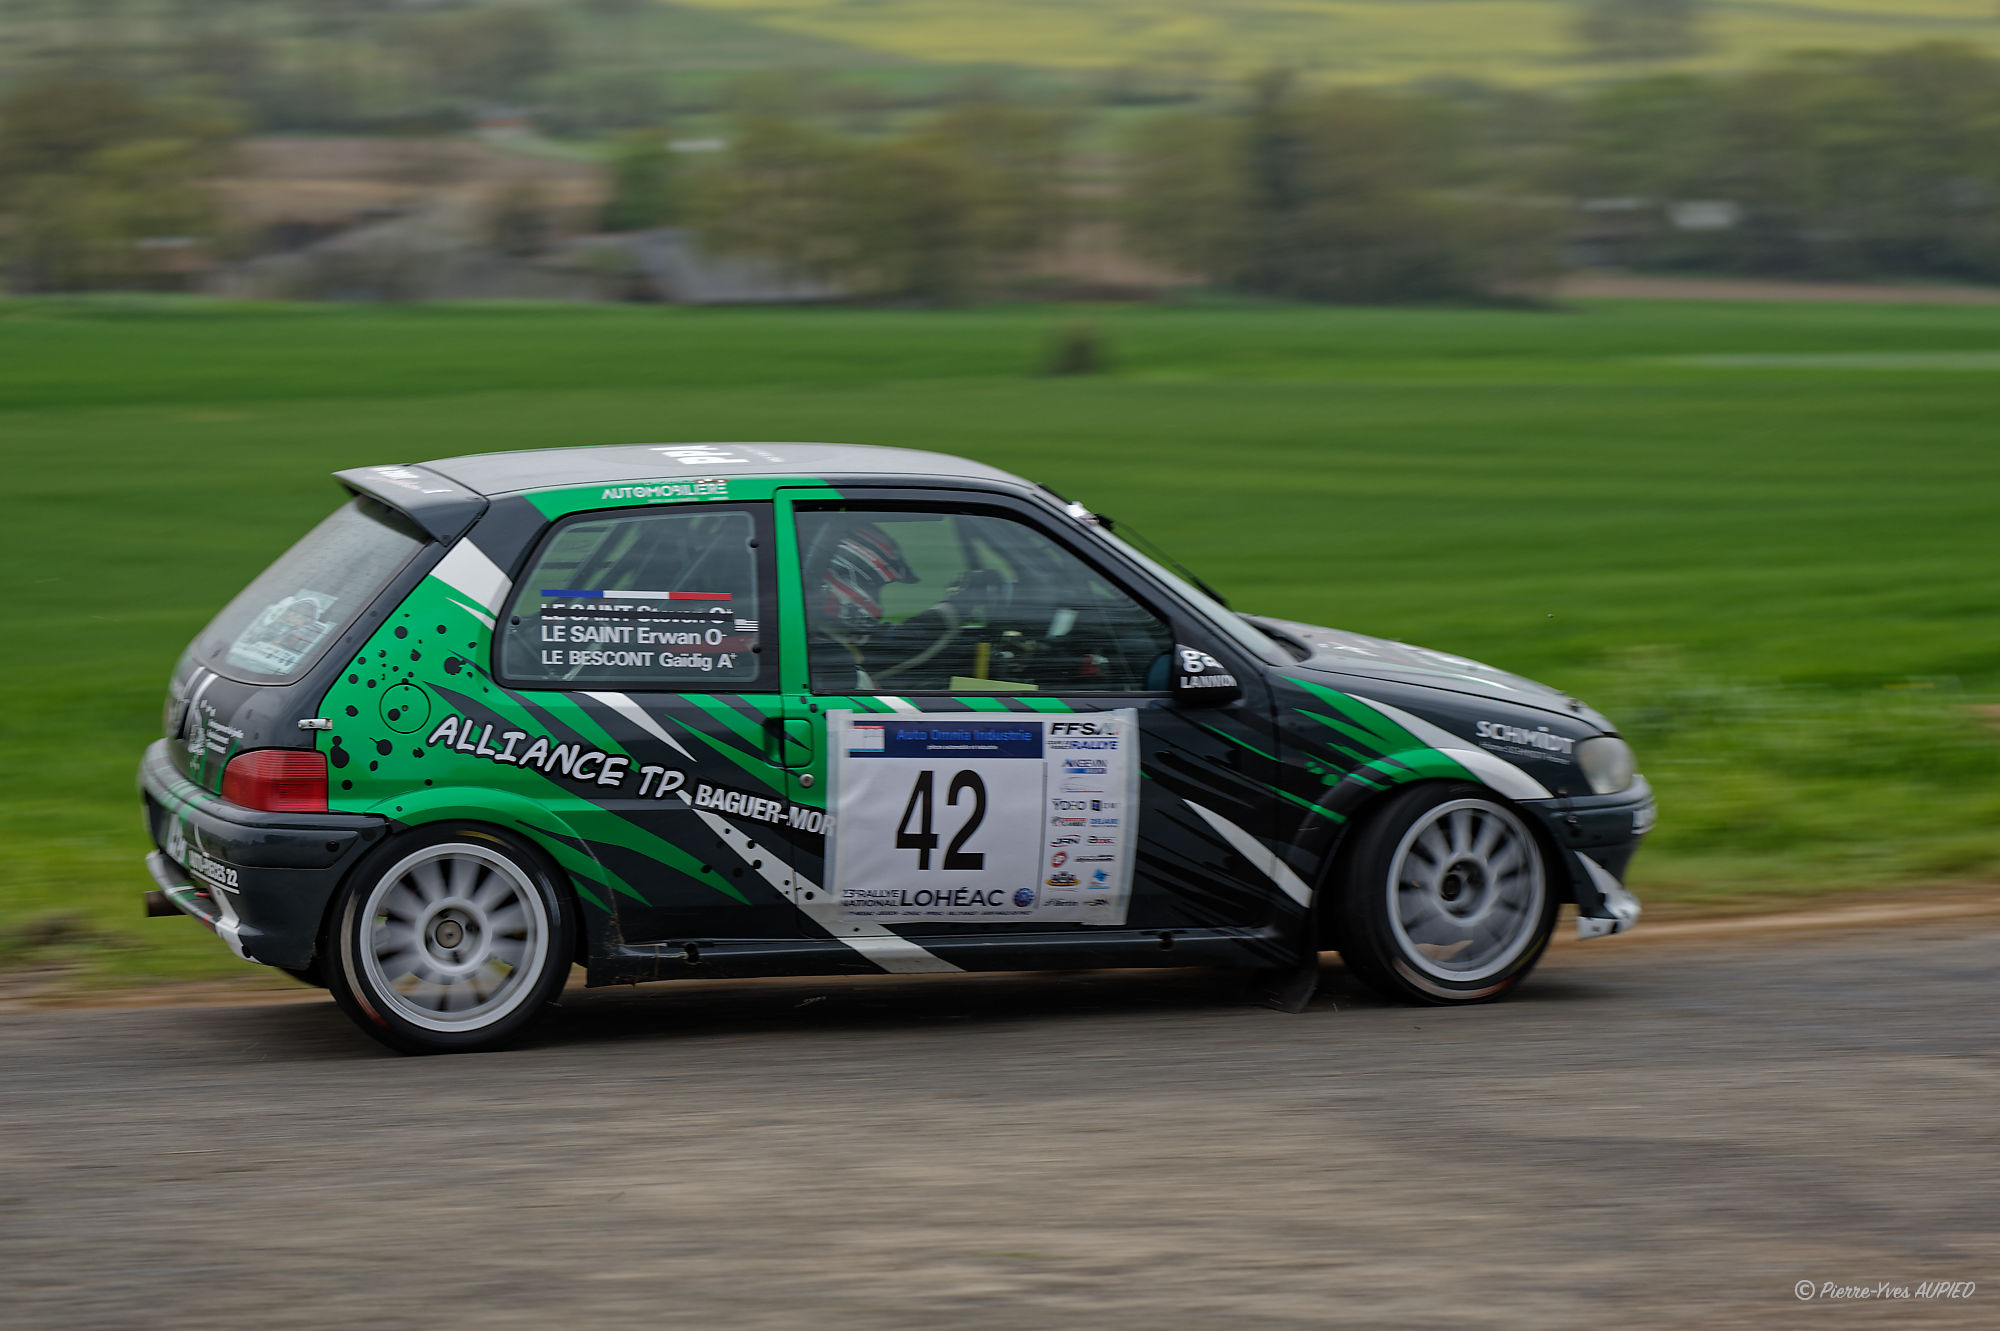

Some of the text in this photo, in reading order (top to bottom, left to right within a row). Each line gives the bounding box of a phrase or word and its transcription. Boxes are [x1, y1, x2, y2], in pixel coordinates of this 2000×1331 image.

[541, 625, 567, 642] LE
[570, 626, 634, 643] SAINT
[637, 627, 702, 645] Erwan
[541, 650, 564, 665] LE
[569, 651, 655, 667] BESCONT
[896, 729, 1032, 741] Auto Omnia Industrie
[428, 716, 686, 797] ALLIANCE TP
[895, 769, 987, 870] 42
[226, 869, 239, 888] 22
[901, 887, 1006, 907] LOHÉAC
